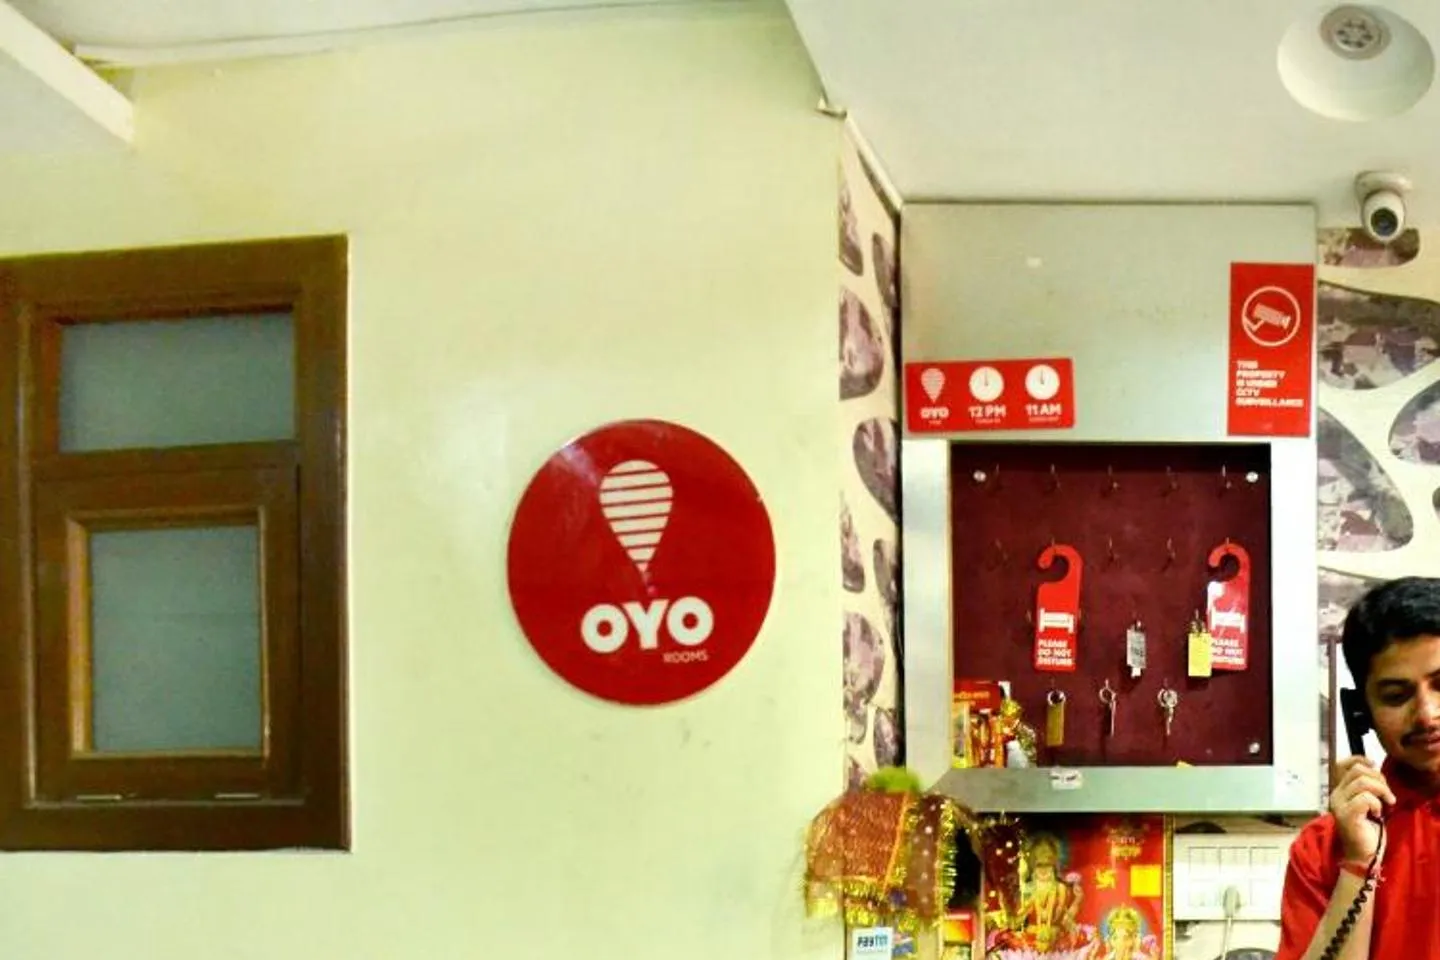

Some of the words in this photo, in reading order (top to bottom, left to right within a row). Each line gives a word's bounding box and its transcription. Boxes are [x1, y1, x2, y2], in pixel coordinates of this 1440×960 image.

[1236, 369, 1286, 379] PROPERTY
[920, 406, 949, 419] OYO
[968, 406, 983, 419] 12
[984, 405, 1007, 418] PM
[1025, 404, 1039, 416] 11
[1040, 403, 1063, 416] AM
[581, 595, 715, 653] OYO
[1038, 639, 1068, 648] PLEASE
[662, 649, 709, 663] ROOMS
[1038, 648, 1051, 657] DO
[1053, 648, 1072, 658] NOT
